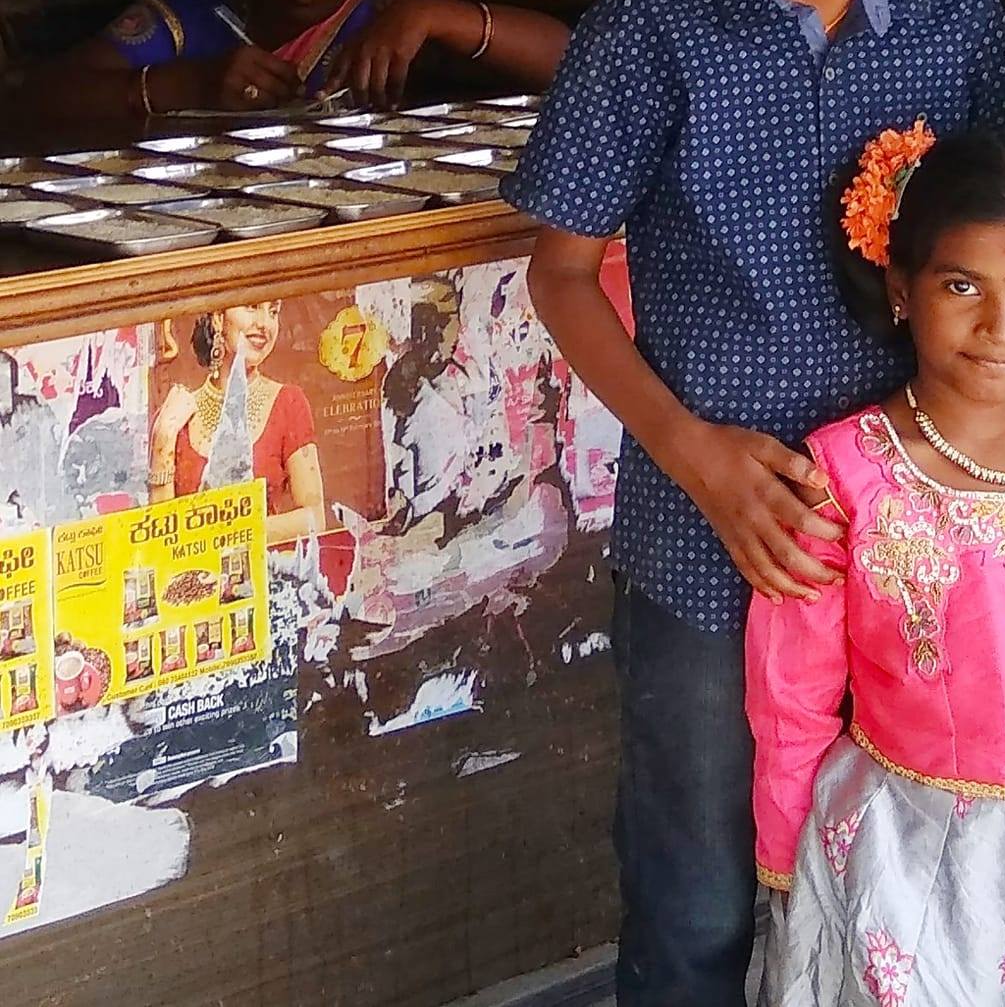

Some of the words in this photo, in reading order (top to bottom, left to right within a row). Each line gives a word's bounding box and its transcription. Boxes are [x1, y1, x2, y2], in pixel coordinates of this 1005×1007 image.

[341, 323, 366, 369] 7
[56, 542, 103, 576] KATSU
[172, 539, 206, 560] KATSU
[213, 528, 253, 550] COFFEE
[168, 700, 195, 719] CASH
[197, 694, 224, 714] BACK
